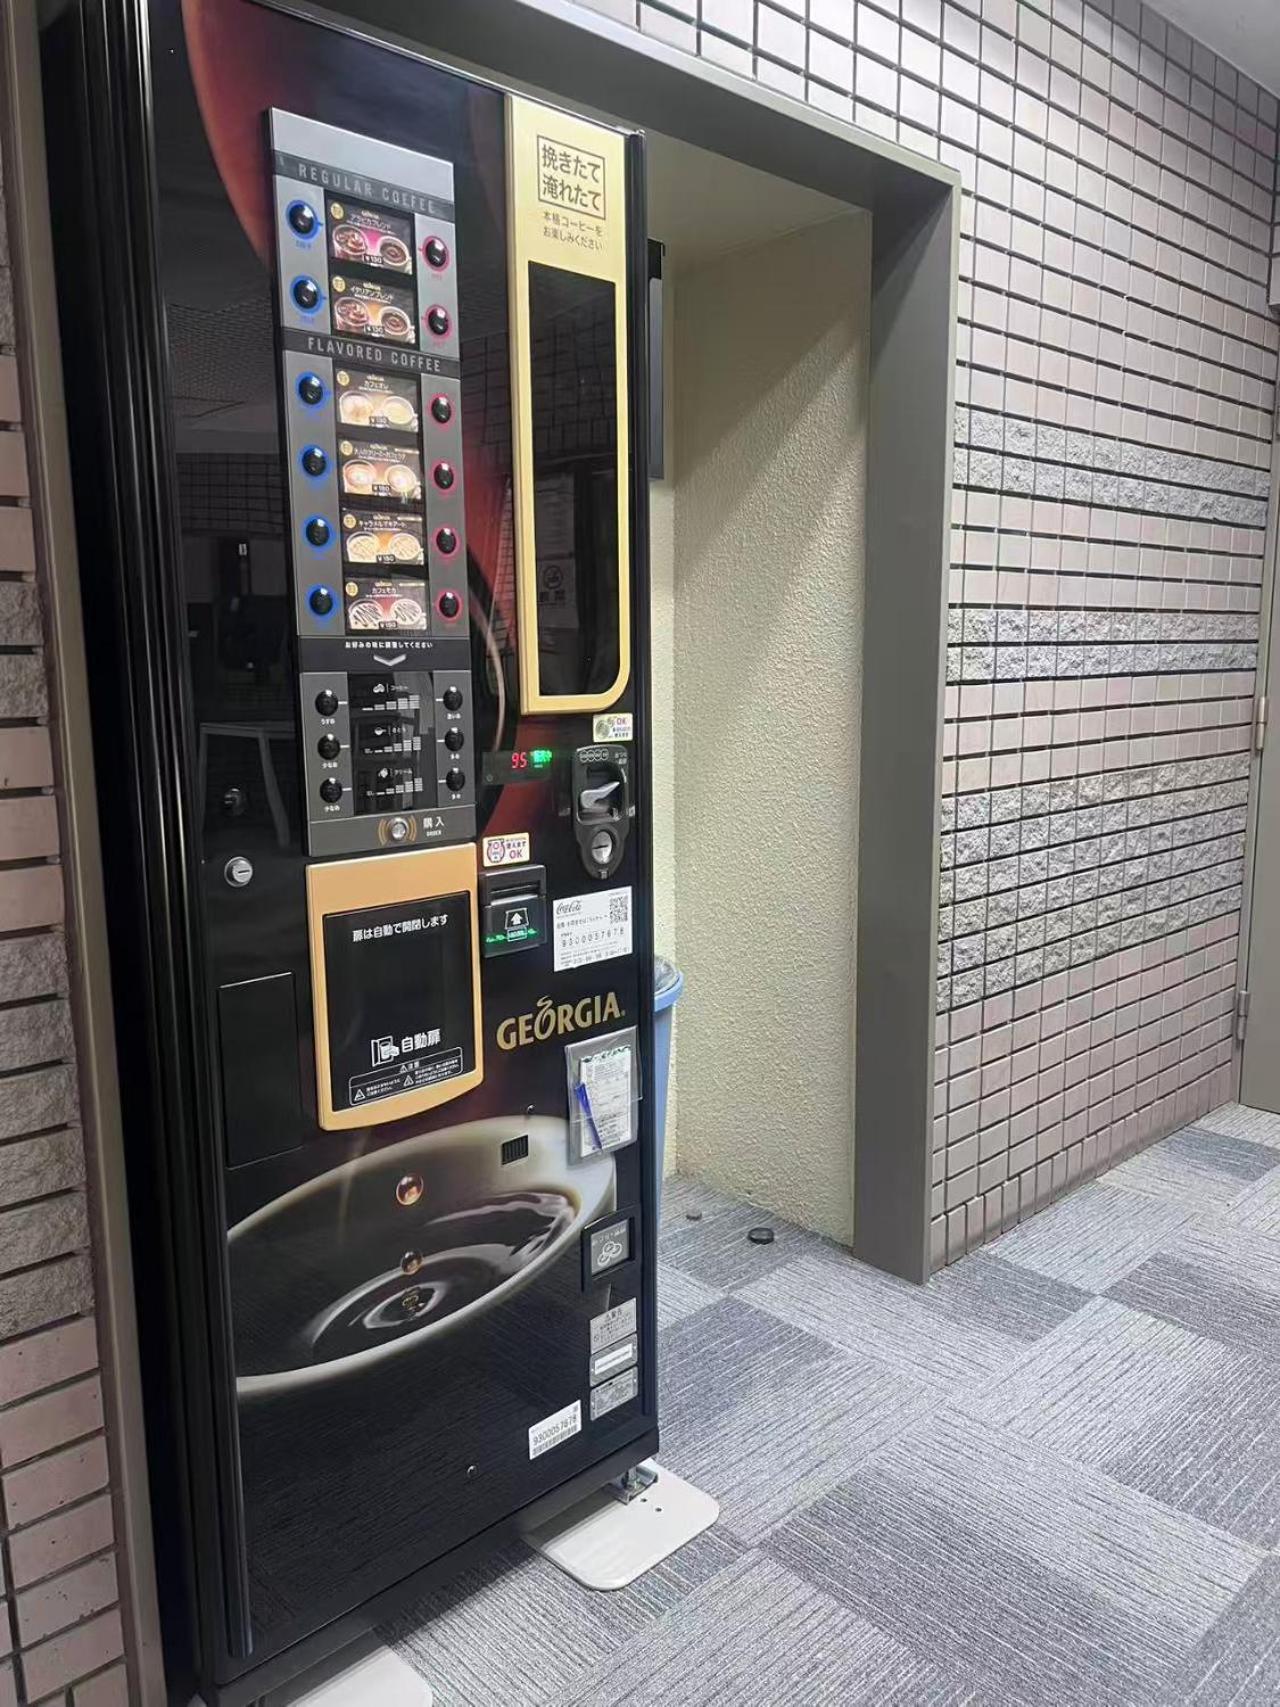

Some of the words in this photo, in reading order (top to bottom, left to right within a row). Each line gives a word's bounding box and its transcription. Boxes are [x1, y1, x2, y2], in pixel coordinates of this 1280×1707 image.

[542, 143, 602, 184] 挽きたて
[298, 163, 372, 197] REGULAR
[542, 173, 603, 212] 淹れたて
[543, 210, 604, 237] 本格コーヒーを
[543, 226, 604, 251] お楽しみください
[308, 337, 382, 362] FLAVORED
[390, 351, 441, 373] COFFEE
[511, 751, 528, 769] 95
[509, 849, 524, 860] OK
[352, 913, 449, 943] 扉は自動で開閉します
[496, 991, 621, 1050] GEORGIA
[401, 1028, 441, 1053] 自動扉
